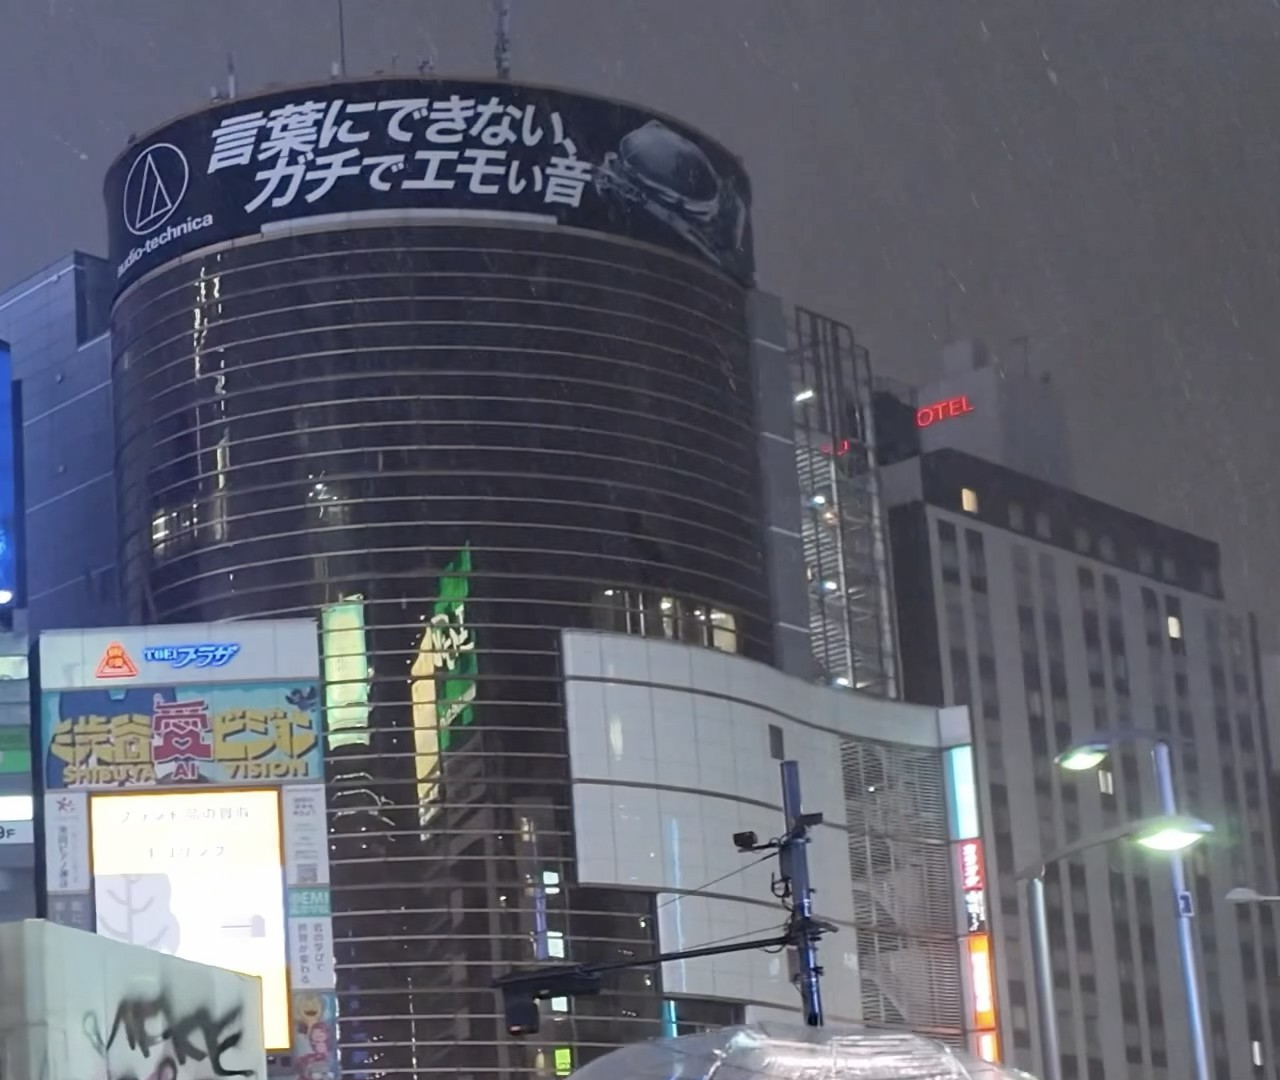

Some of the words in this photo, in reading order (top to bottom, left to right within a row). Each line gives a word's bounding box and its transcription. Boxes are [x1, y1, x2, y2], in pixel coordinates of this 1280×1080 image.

[207, 95, 577, 174] 言葉にできない、
[244, 148, 593, 213] ガチでエモい音
[916, 396, 975, 427] OTEL
[62, 763, 156, 786] SHIBUYA
[172, 762, 198, 781] AI
[226, 761, 309, 780] VISION
